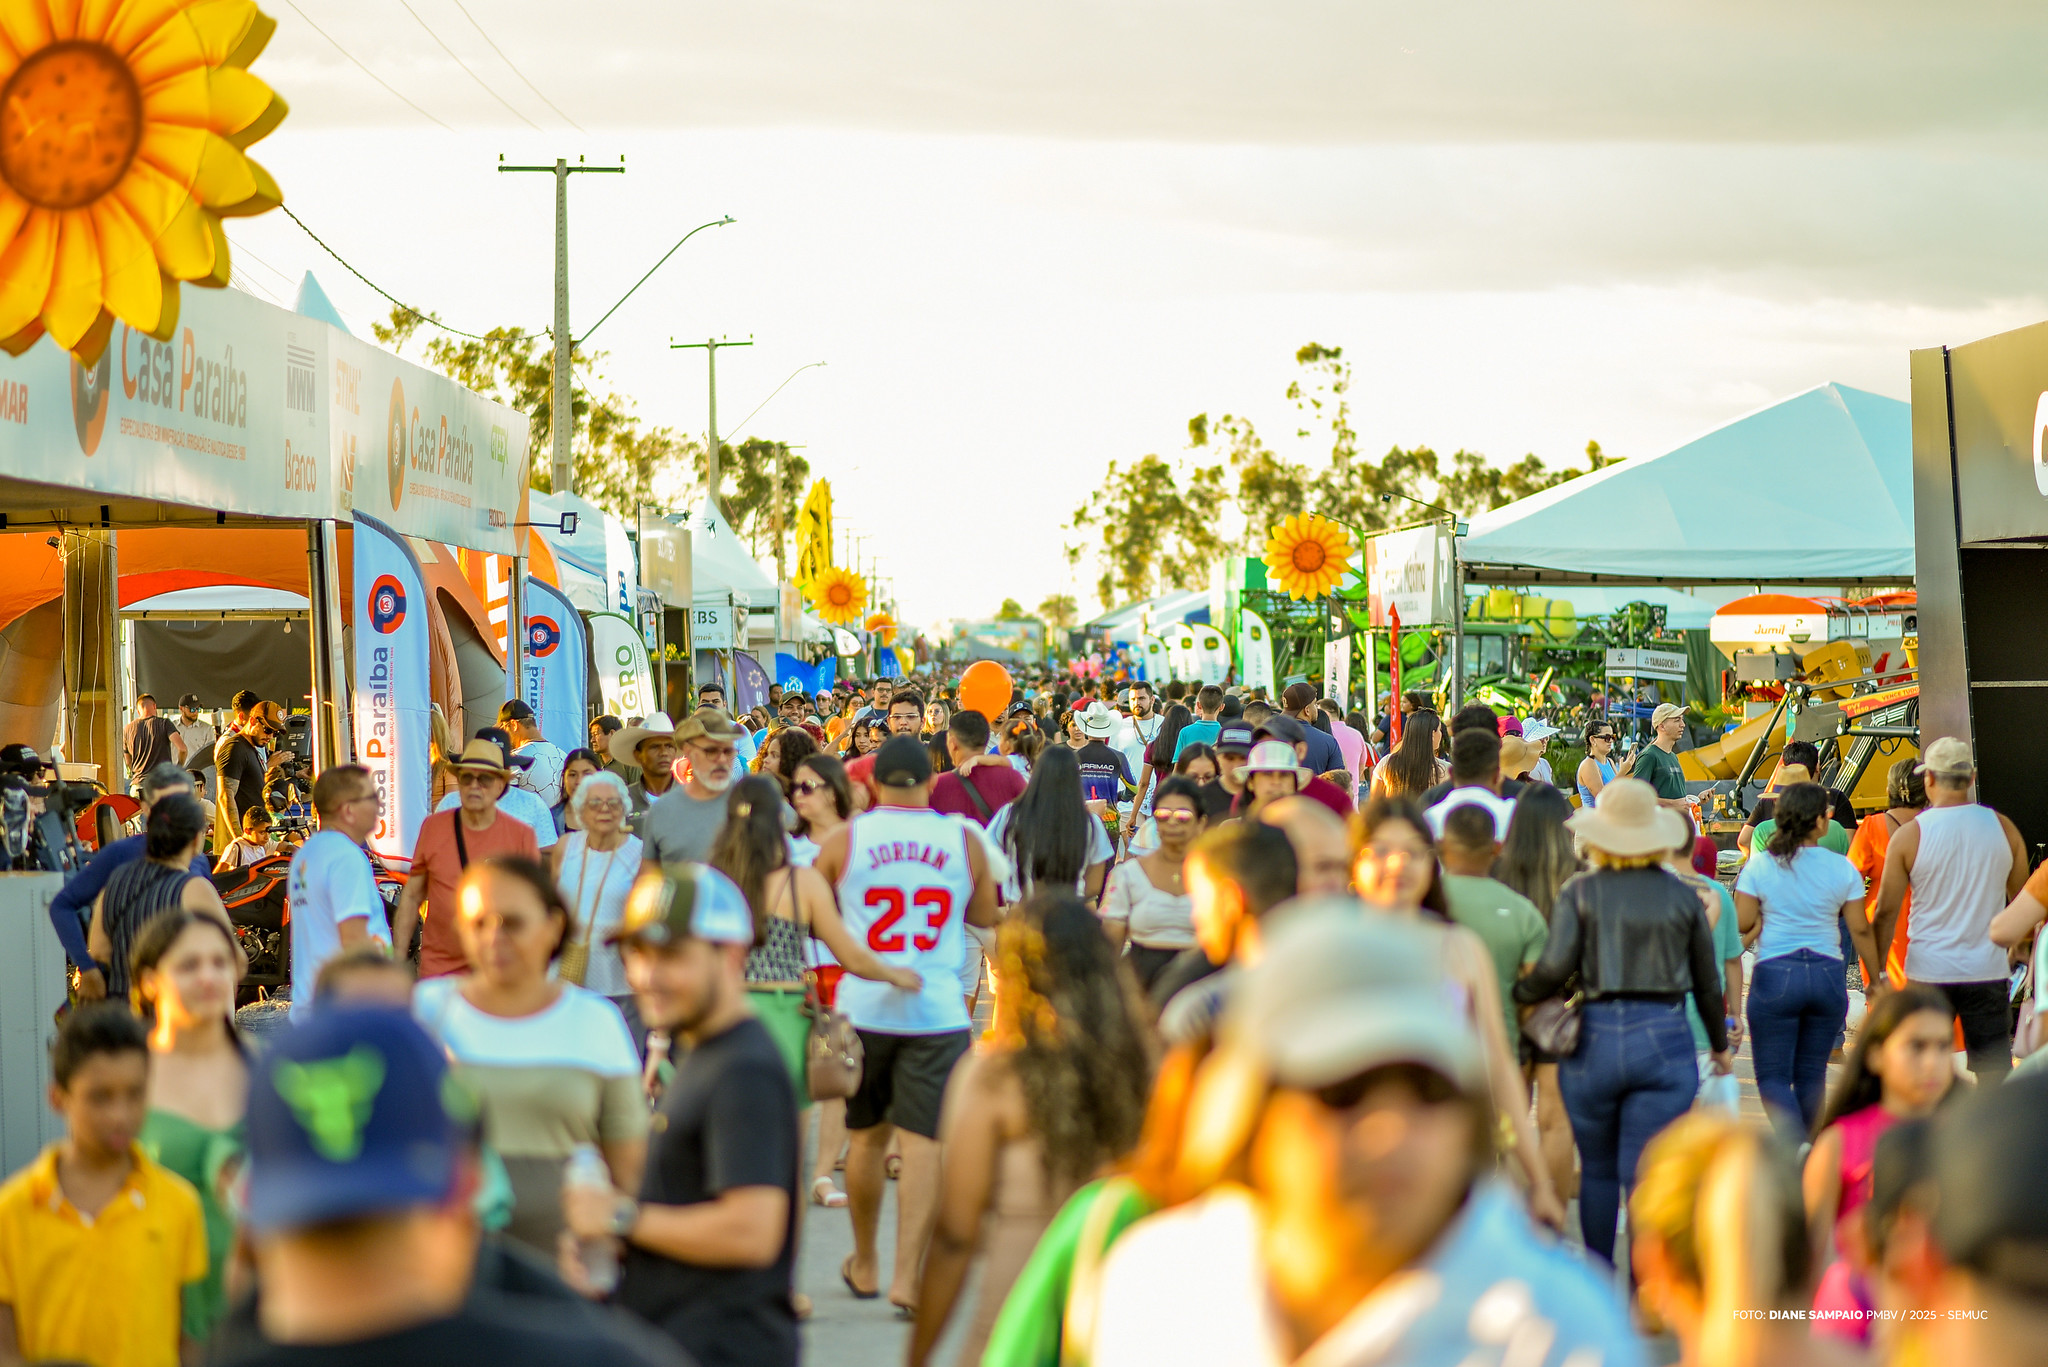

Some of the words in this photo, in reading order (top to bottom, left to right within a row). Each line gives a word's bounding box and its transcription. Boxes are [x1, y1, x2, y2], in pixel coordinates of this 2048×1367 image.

[122, 323, 174, 408] Casa
[179, 326, 247, 429] Paraíba
[287, 365, 315, 413] MWM
[336, 357, 360, 416] STIHL
[285, 438, 316, 493] Branco
[410, 405, 435, 474] Casa
[437, 415, 473, 486] Paraíba
[488, 508, 507, 529] HONDA
[1754, 624, 1786, 636] Jumil
[366, 646, 388, 759] Paraíba
[868, 841, 951, 872] JORDAN
[864, 886, 954, 953] 23
